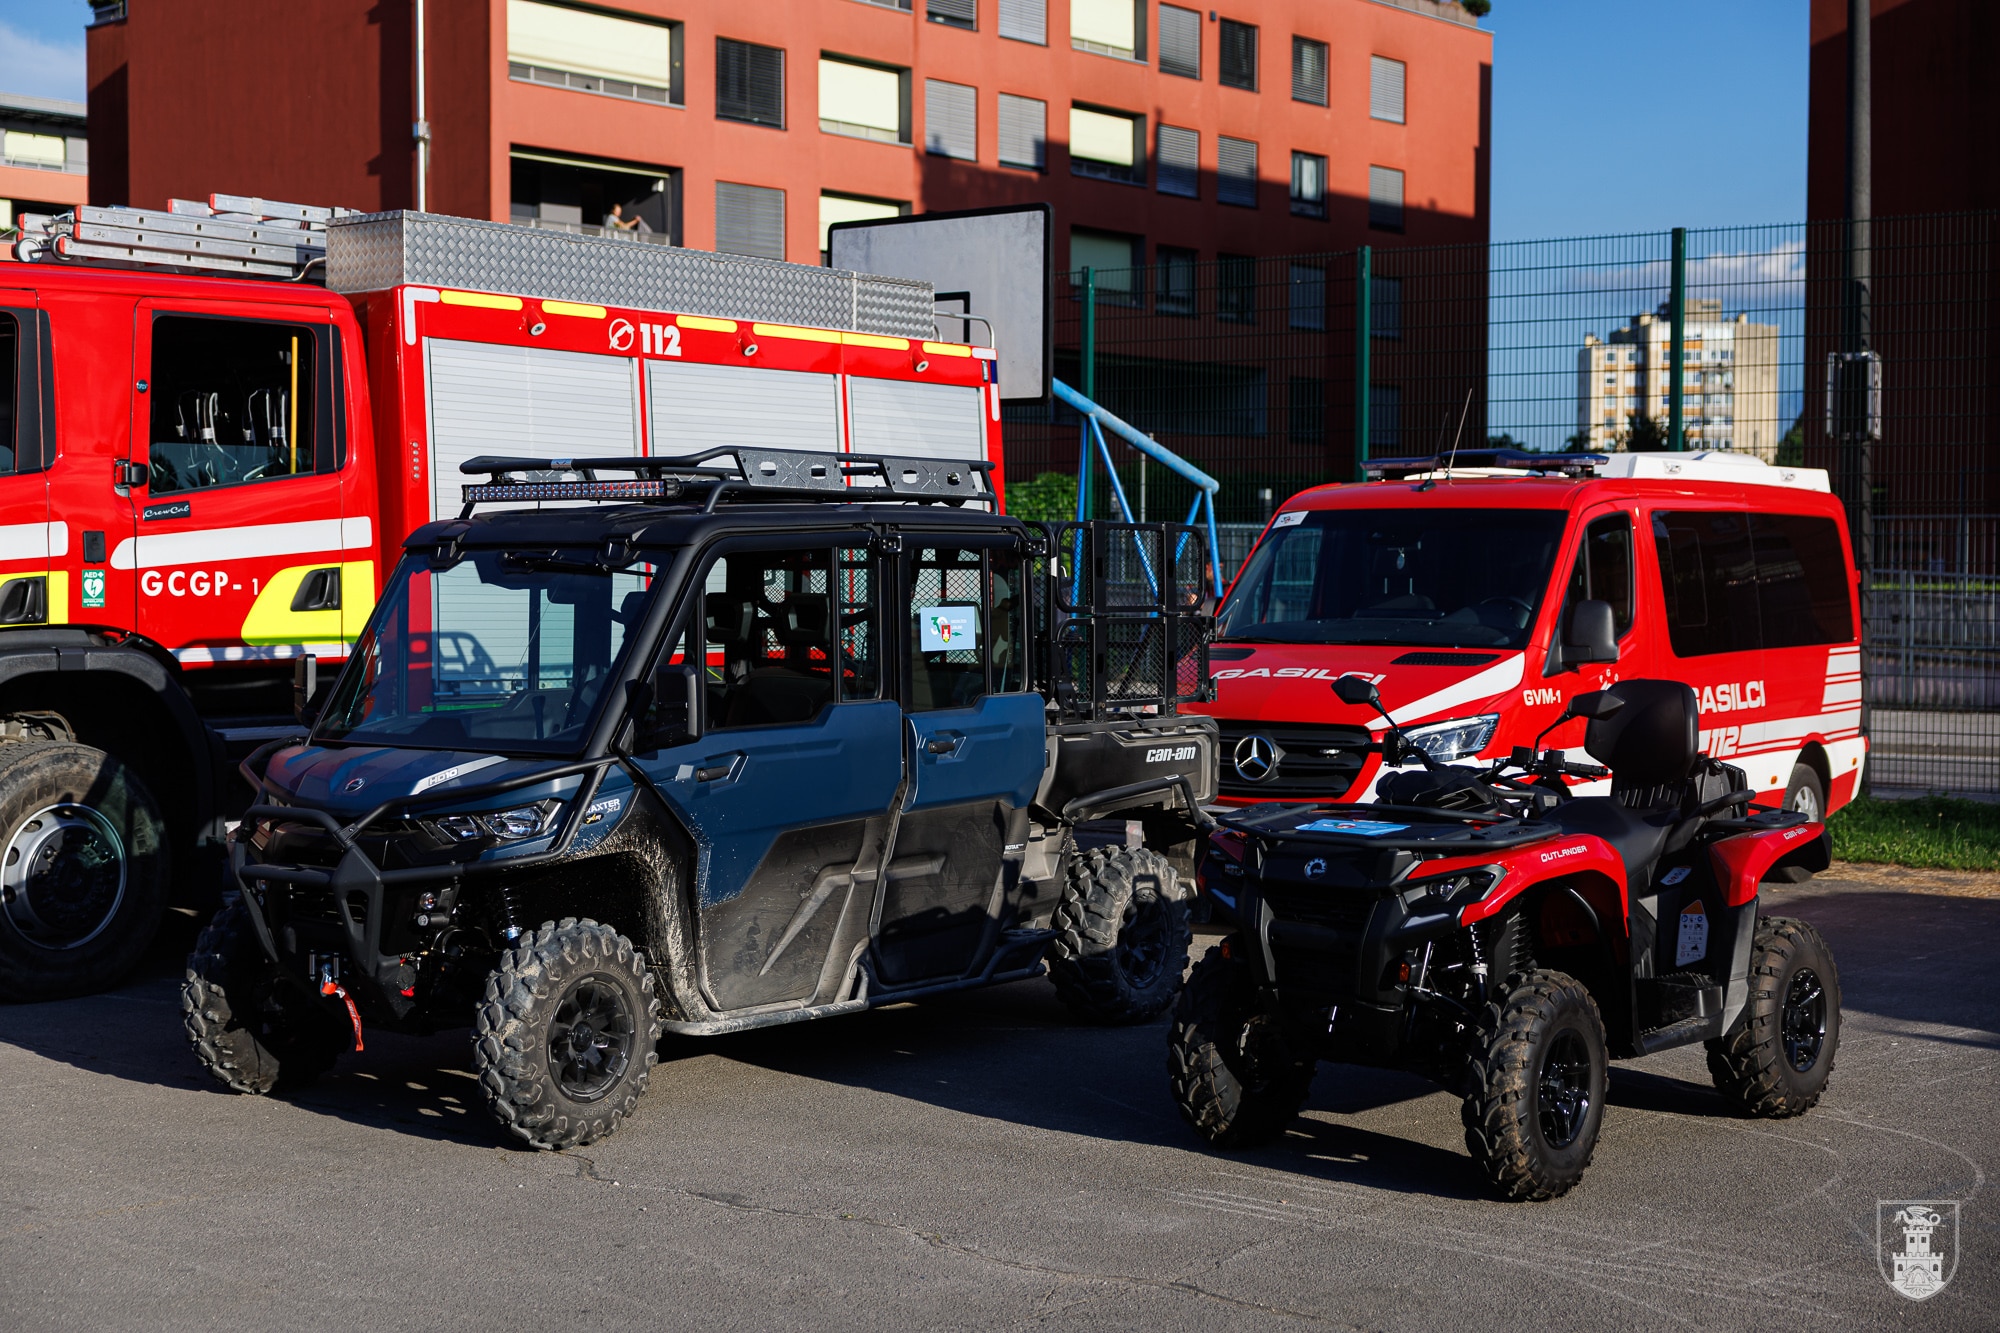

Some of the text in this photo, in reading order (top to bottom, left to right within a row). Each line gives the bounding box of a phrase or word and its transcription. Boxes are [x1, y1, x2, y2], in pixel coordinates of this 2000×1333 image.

[640, 323, 682, 357] 112
[144, 504, 190, 518] CrewCab
[1523, 688, 1561, 706] GVM-1
[1708, 726, 1740, 759] 112
[1145, 746, 1197, 763] can-am
[429, 768, 458, 786] HD10
[586, 798, 621, 814] AXTER
[1540, 845, 1588, 863] OUTLANDER
